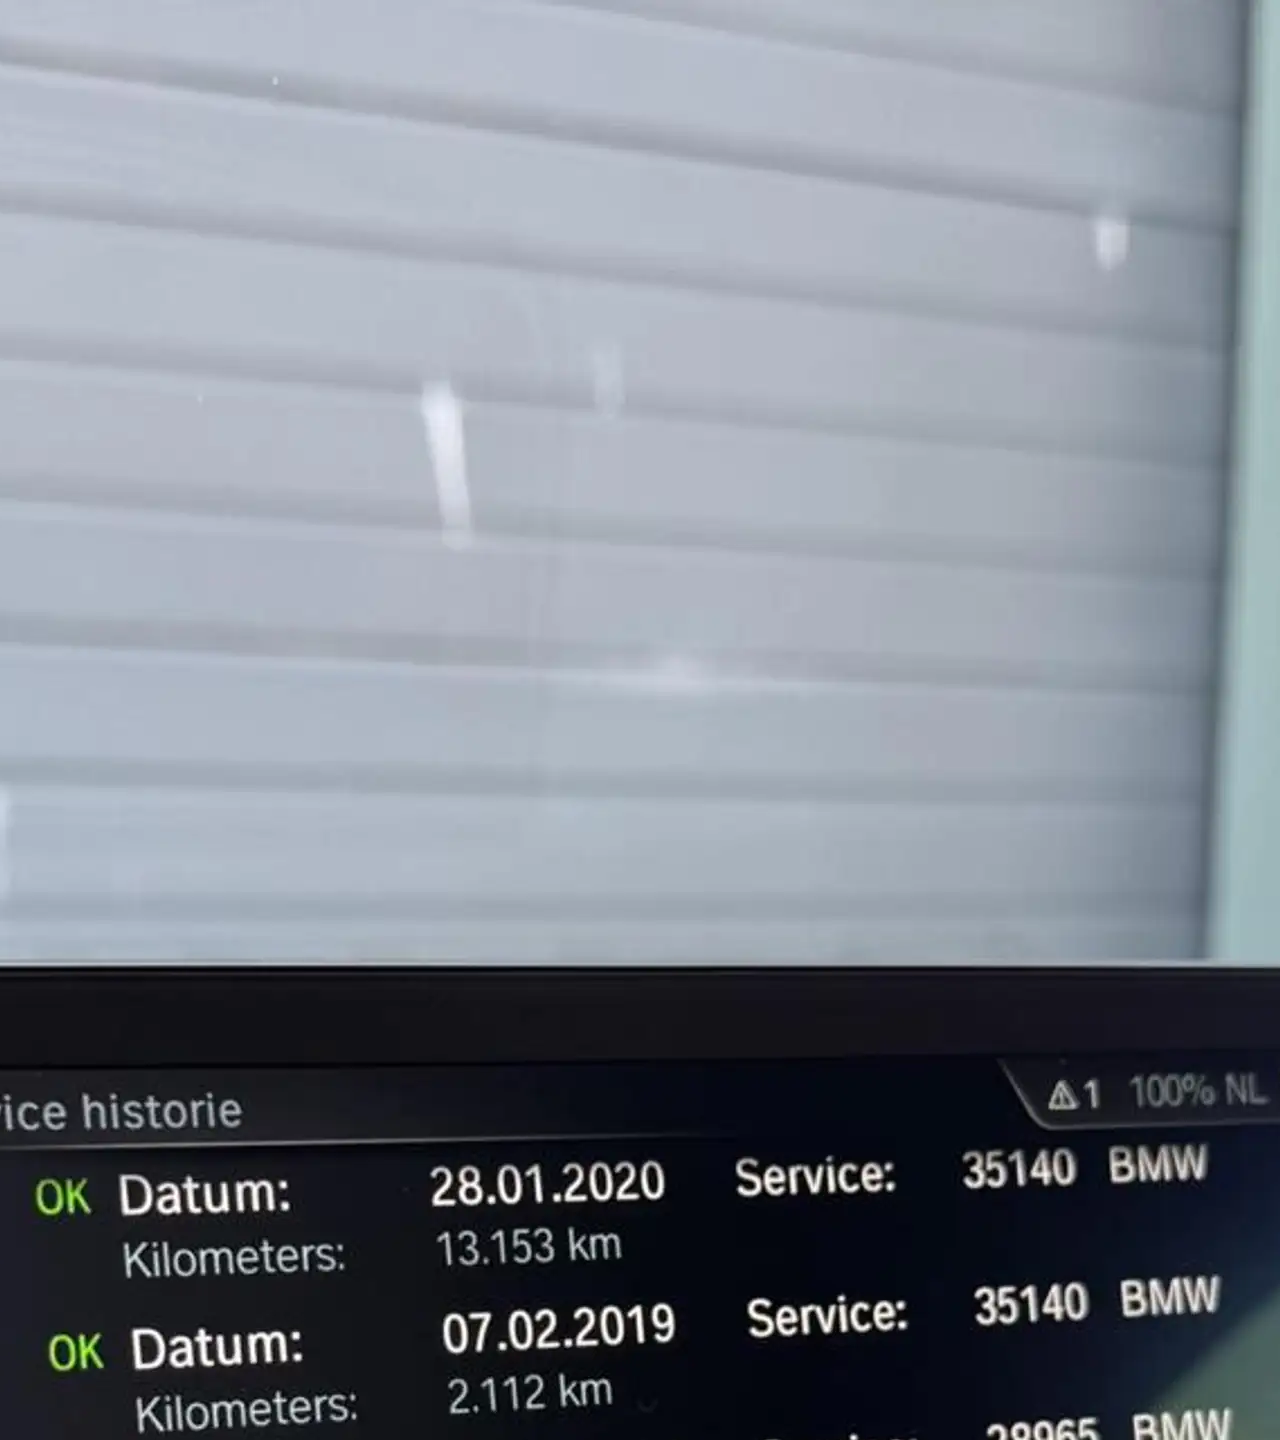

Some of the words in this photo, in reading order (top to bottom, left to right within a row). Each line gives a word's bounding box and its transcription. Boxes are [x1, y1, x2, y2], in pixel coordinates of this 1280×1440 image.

[81, 1092, 242, 1130] historie
[1083, 1079, 1101, 1109] 1
[1130, 1073, 1217, 1108] 100%
[1224, 1072, 1270, 1105] NL
[36, 1178, 91, 1216] OK
[119, 1174, 290, 1216] Datum:
[430, 1160, 665, 1207] 28.01.2020
[735, 1155, 895, 1197] Service:
[963, 1148, 1076, 1189] 35140
[1109, 1145, 1206, 1184] BMW
[123, 1239, 345, 1279] Kilometers:
[437, 1227, 555, 1266] 13.153
[568, 1227, 622, 1261] km
[49, 1333, 104, 1371] OK
[131, 1327, 303, 1370] Datum:
[443, 1302, 675, 1354] 07.02.2019
[747, 1294, 908, 1338] Service:
[974, 1282, 1088, 1326] 35140
[1120, 1275, 1220, 1318] BMW
[136, 1390, 357, 1434] Kilometers:
[447, 1373, 546, 1415] 2.112
[558, 1373, 613, 1407] km
